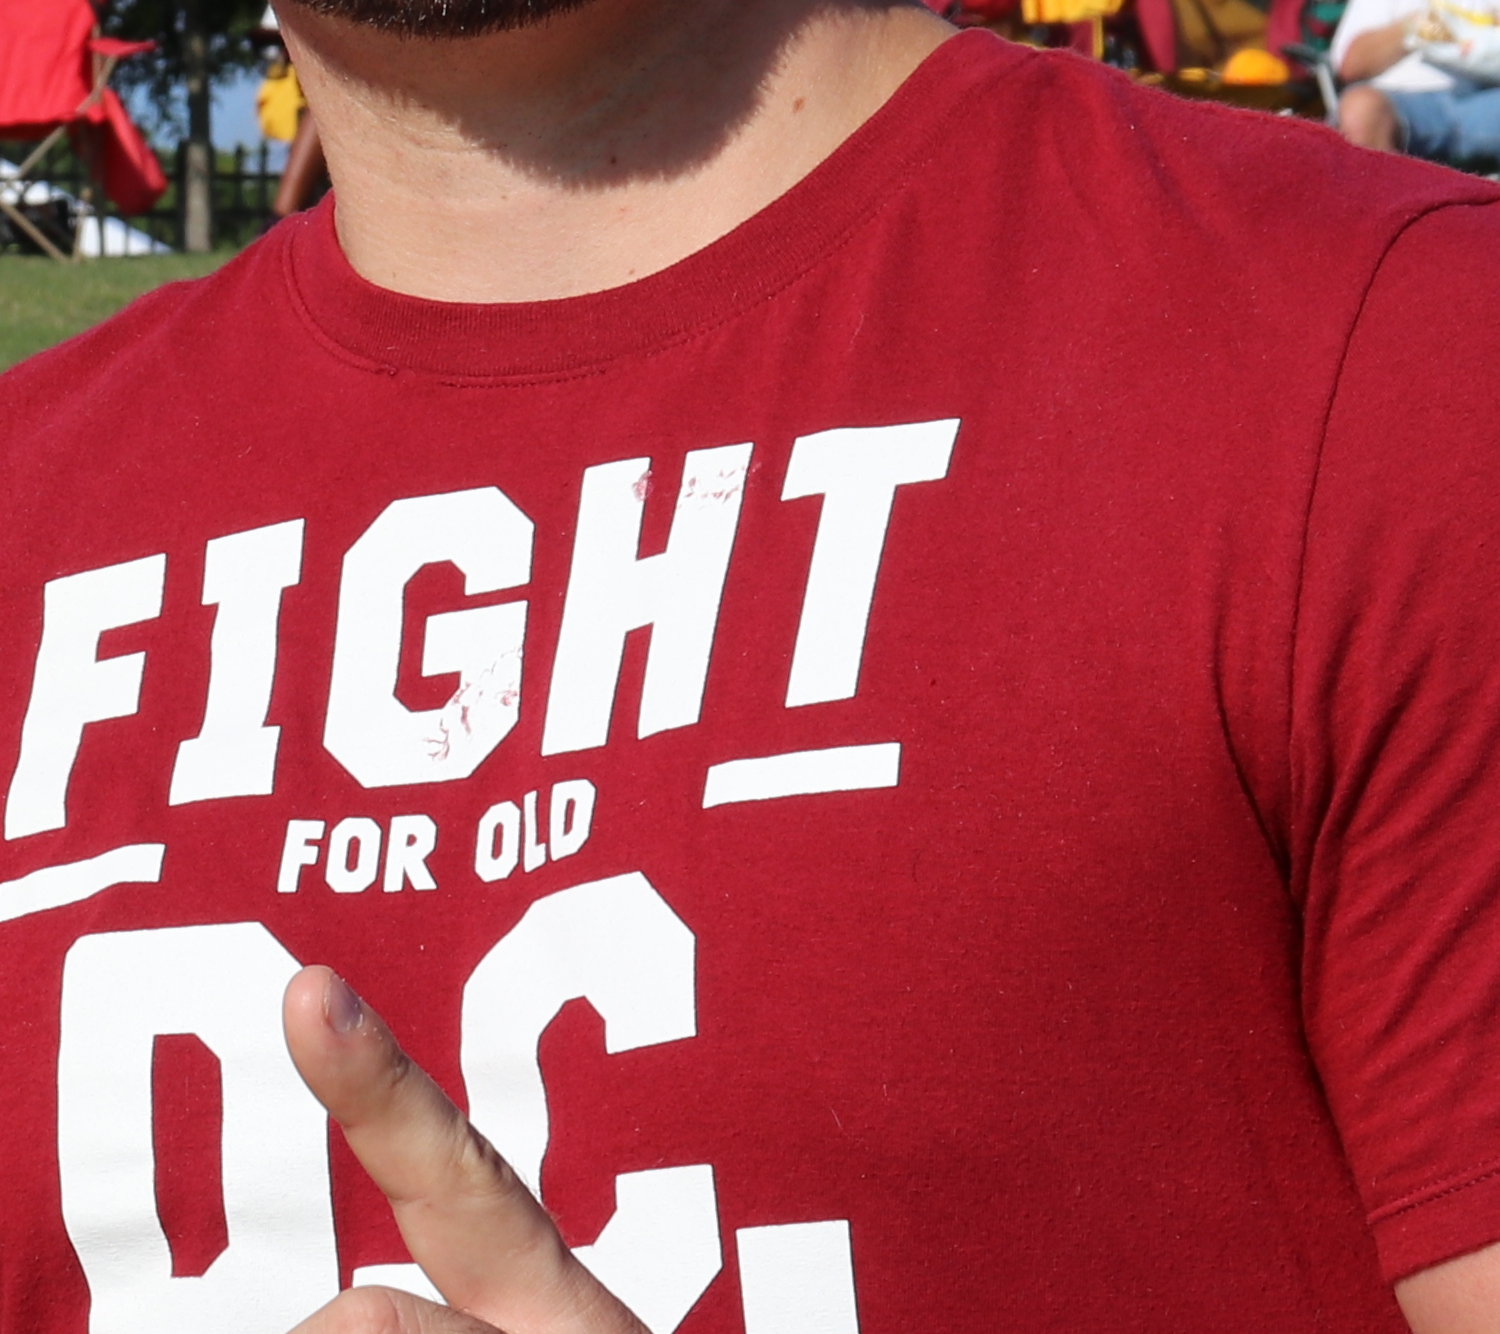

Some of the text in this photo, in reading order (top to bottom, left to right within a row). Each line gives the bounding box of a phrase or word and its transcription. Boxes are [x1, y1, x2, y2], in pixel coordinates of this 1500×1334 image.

[4, 418, 961, 840] FIGHT
[277, 777, 597, 893] FOR OLD
